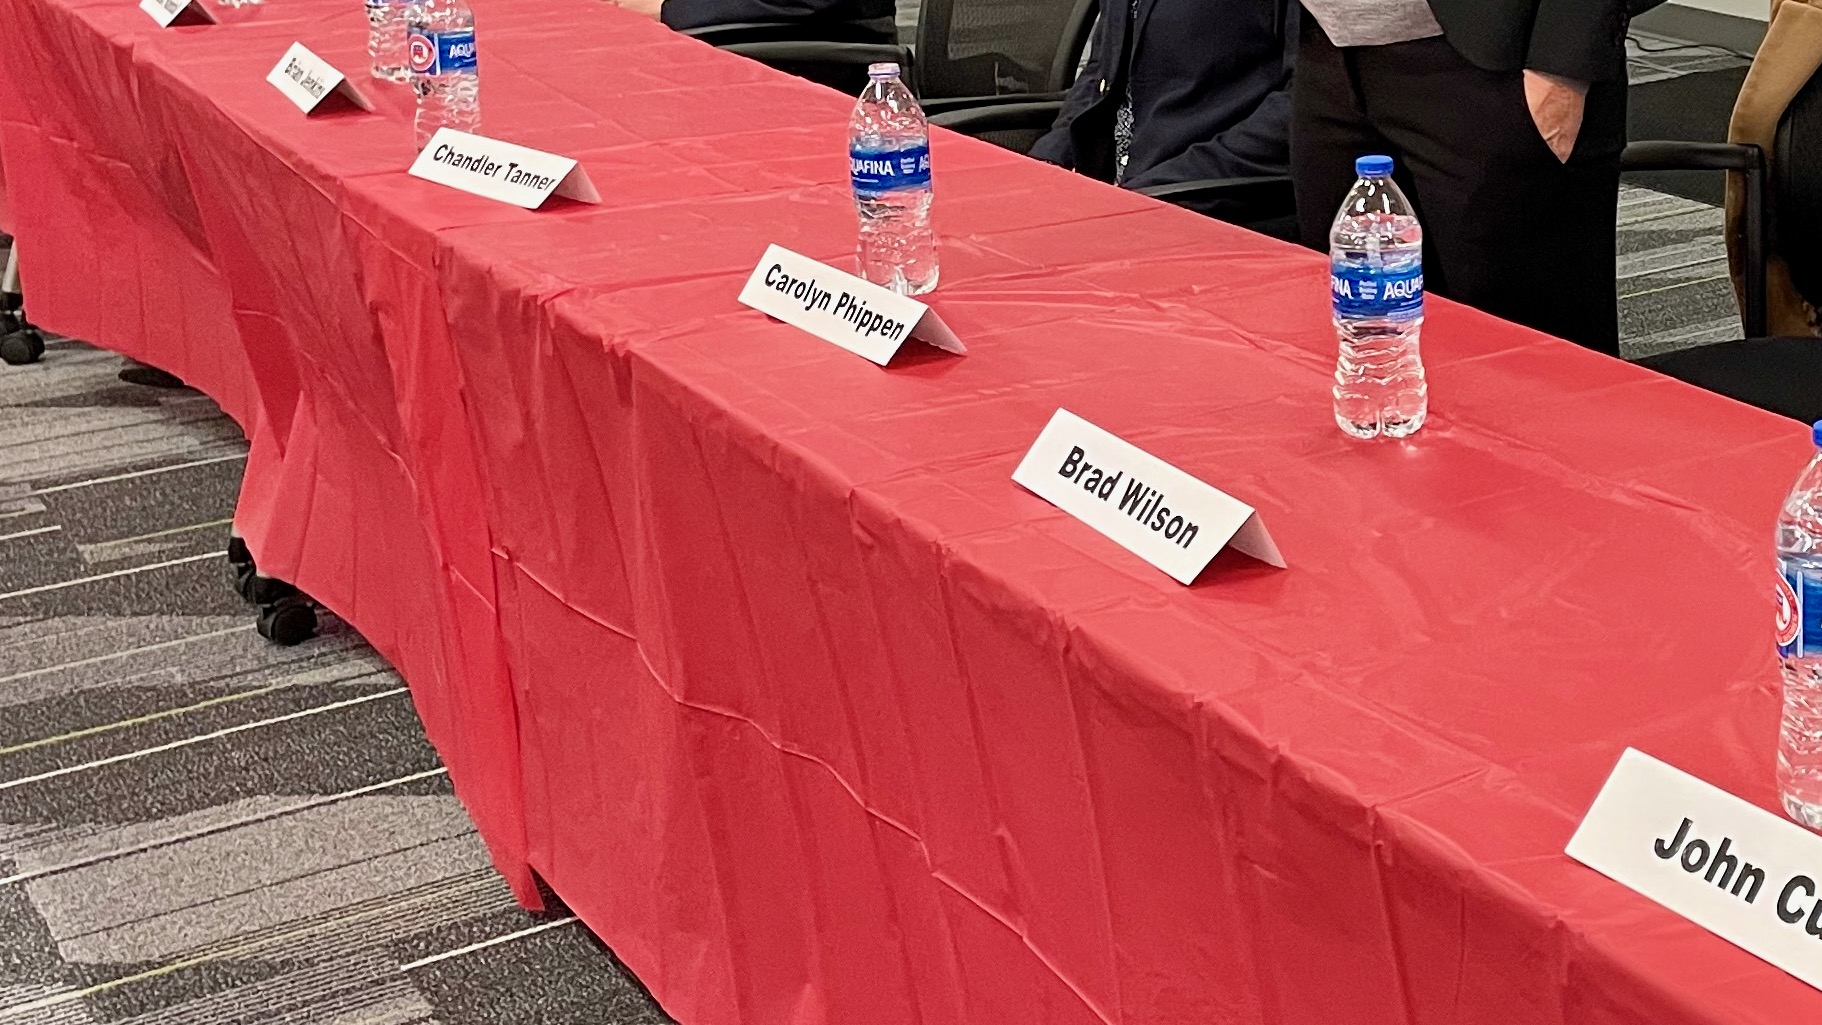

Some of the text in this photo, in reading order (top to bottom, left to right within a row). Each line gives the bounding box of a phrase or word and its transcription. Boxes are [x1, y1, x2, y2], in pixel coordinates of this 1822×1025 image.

[433, 143, 557, 192] Chandler Tanner
[764, 263, 906, 342] Carolyn Phippen
[1057, 445, 1201, 550] Brad Wilson
[1653, 816, 1767, 905] John
